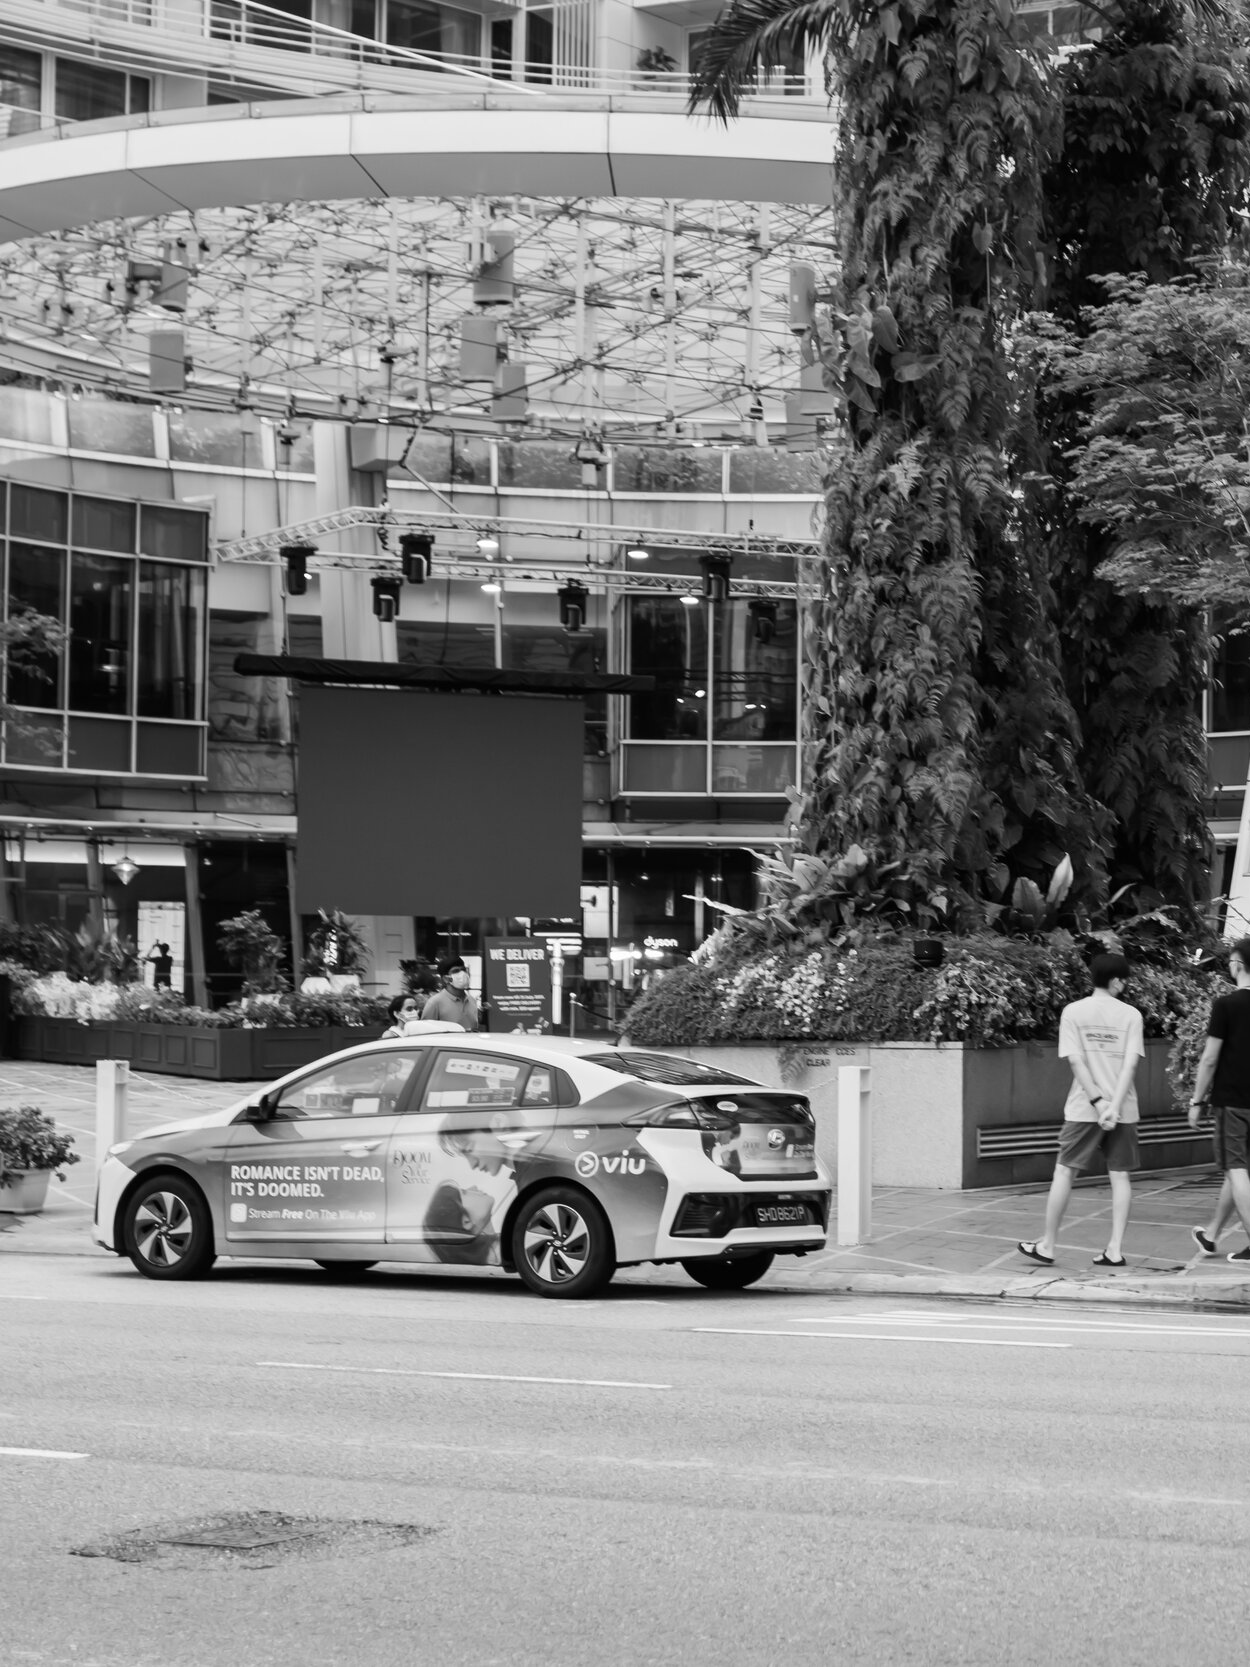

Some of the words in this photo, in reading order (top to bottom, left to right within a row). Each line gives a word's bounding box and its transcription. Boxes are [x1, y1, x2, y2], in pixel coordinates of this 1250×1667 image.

[643, 935, 678, 950] dyson
[489, 948, 506, 961] WE
[506, 948, 545, 961] DELIVER
[806, 1058, 831, 1067] CLEAR
[602, 1149, 646, 1175] viu
[231, 1165, 301, 1180] ROMANCE
[304, 1166, 340, 1181] ISN'T
[343, 1166, 385, 1183] DEAD,
[231, 1182, 255, 1197] IT'S
[258, 1182, 325, 1198] DOOMED.
[248, 1208, 280, 1219] Stream
[281, 1208, 304, 1219] Free
[305, 1208, 319, 1219] On
[320, 1208, 337, 1220] The
[357, 1209, 376, 1223] App
